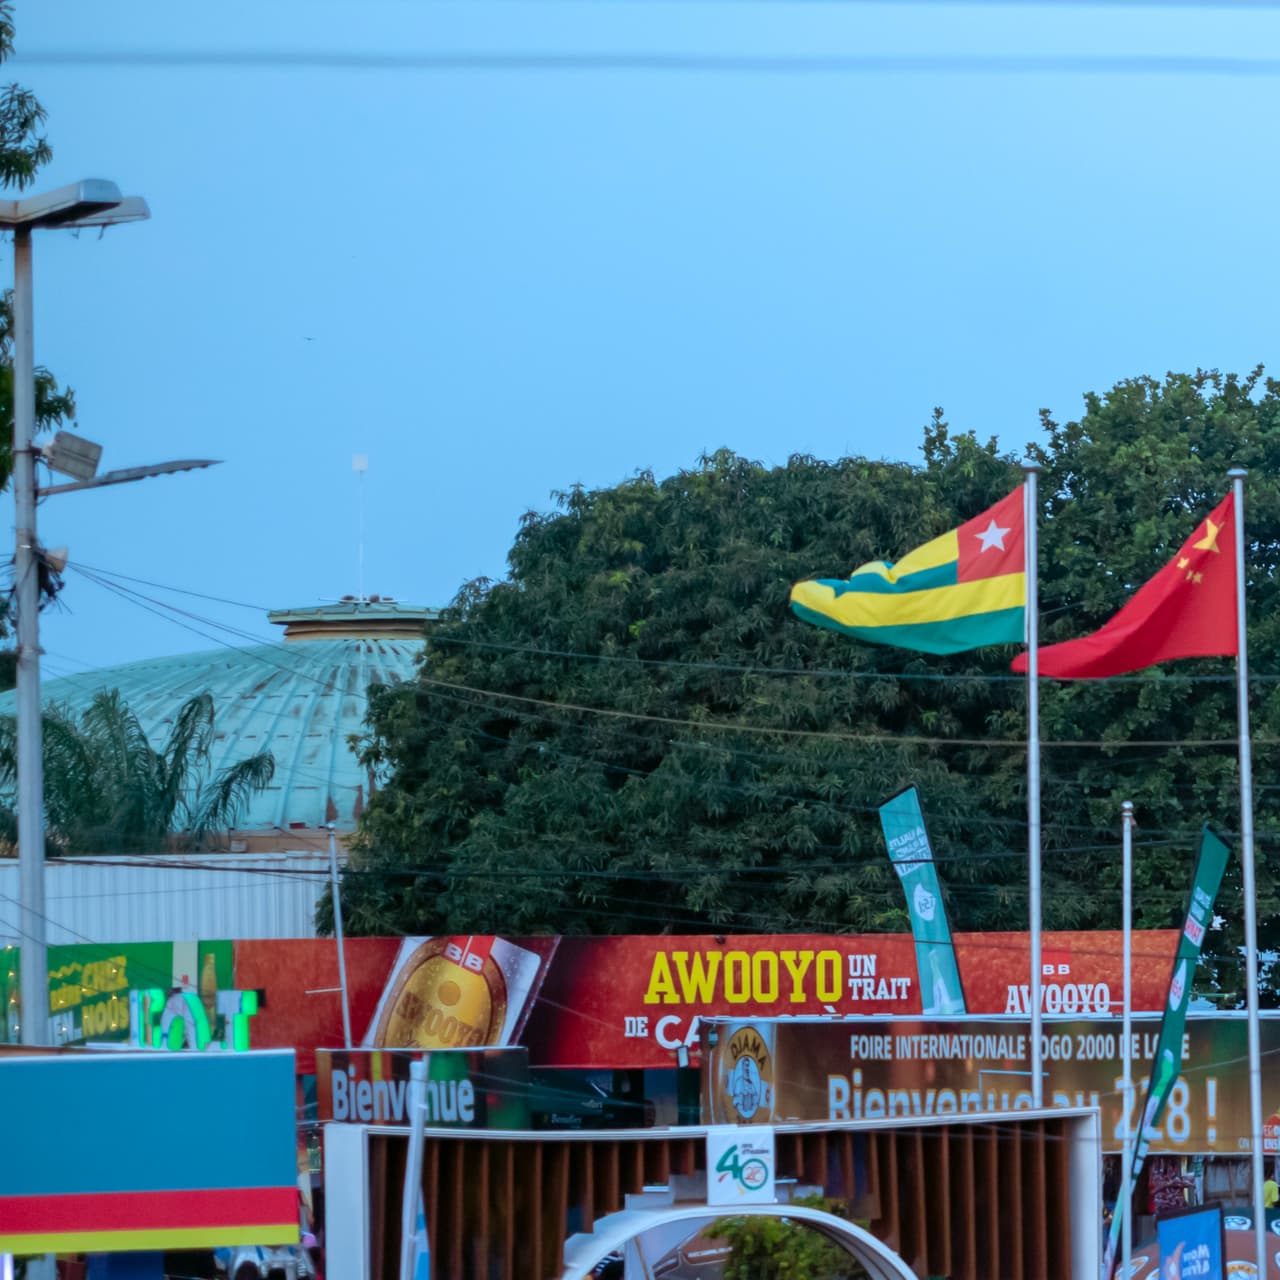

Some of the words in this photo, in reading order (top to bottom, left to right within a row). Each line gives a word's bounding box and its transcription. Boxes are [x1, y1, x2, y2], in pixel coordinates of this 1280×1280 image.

[643, 950, 842, 1004] AWOOYO
[848, 954, 877, 976] UN
[848, 977, 911, 1001] TRAIT
[1004, 983, 1111, 1014] AWOOYO
[624, 1016, 648, 1037] DE
[730, 1034, 768, 1072] DJAMA
[850, 1036, 891, 1060] FOIRE
[896, 1035, 1025, 1060] INTERNATIONALE
[1030, 1035, 1072, 1060] OGO
[1077, 1035, 1114, 1060] 2000
[1144, 1034, 1190, 1060] LE
[331, 1065, 475, 1122] Bienvnue
[1205, 1078, 1219, 1142] !
